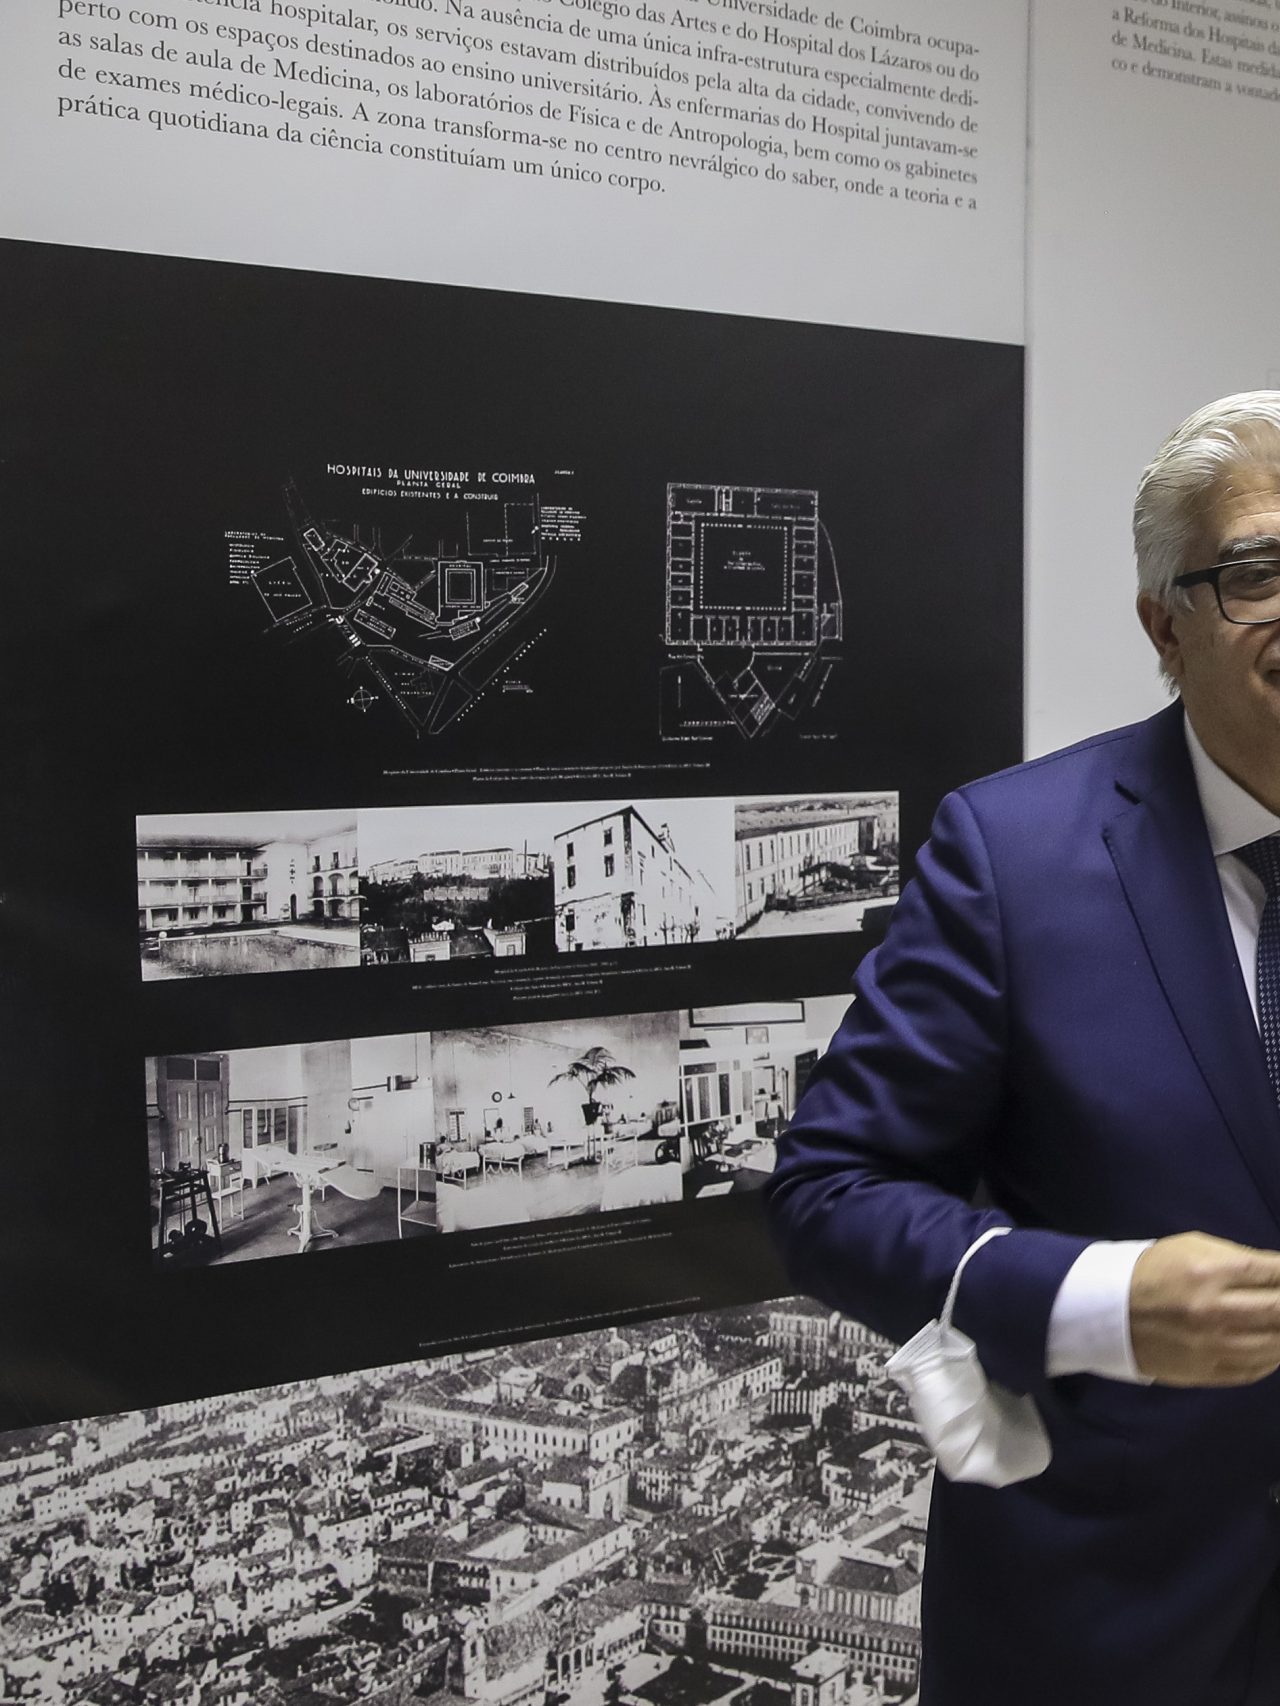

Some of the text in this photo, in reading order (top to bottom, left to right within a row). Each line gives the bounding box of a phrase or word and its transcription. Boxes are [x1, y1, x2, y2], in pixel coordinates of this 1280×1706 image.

[444, 0, 475, 19] Na
[481, 8, 564, 34] ausência
[569, 18, 591, 39] de
[597, 28, 638, 48] uma
[643, 31, 692, 57] única
[697, 40, 820, 80] infra-estrutura
[824, 70, 936, 100] especialmente
[939, 86, 979, 107] dedi-
[636, 2, 665, 24] das
[670, 9, 717, 34] Artes
[722, 24, 731, 36] e
[736, 21, 758, 41] do
[763, 25, 833, 56] Hospital
[838, 40, 866, 61] dos
[871, 45, 932, 73] Lázaros
[936, 64, 955, 78] ou
[959, 64, 979, 82] do
[824, 11, 844, 30] de
[850, 16, 921, 46] Coimbra
[927, 36, 980, 58] ocupa-
[1111, 29, 1127, 48] de
[1133, 34, 1196, 62] Medicina.
[1202, 47, 1233, 70] Estas
[1124, 5, 1179, 35] Reforma
[1183, 20, 1205, 40] dos
[1209, 25, 1265, 53] Hospitais
[58, 0, 978, 158] perto com os espaços destinados ao ensino universitário. Às enfermarias do Hospital juntavam-se
[270, 0, 379, 37] hospitalar,
[387, 22, 408, 37] os
[415, 26, 493, 54] serviços
[500, 41, 577, 66] estavam
[584, 50, 689, 85] distribuídos
[695, 72, 732, 92] pela
[738, 77, 769, 98] alta
[775, 83, 796, 103] da
[802, 88, 860, 117] cidade,
[866, 104, 955, 129] convivendo
[960, 115, 978, 133] de
[1112, 58, 1127, 71] co
[1142, 60, 1222, 91] demonstram
[58, 31, 978, 184] as salas de aula de Medicina, os laboratórios de Física e de Antropologia, bem como os gabinetes
[58, 58, 977, 210] de exames médico-legais. A zona transforma-se no centro nevrálgico do saber, onde a teoria e a
[57, 94, 665, 196] prática quotidiana da ciência constituíam um único corpo.
[326, 463, 536, 485] HOSPITAIS DA UNIVERSIDADE DE COIMBRA
[396, 479, 462, 489] PLANTA GERAL
[400, 489, 442, 500] EXISTENTES
[445, 491, 450, 500] E
[453, 491, 460, 500] A
